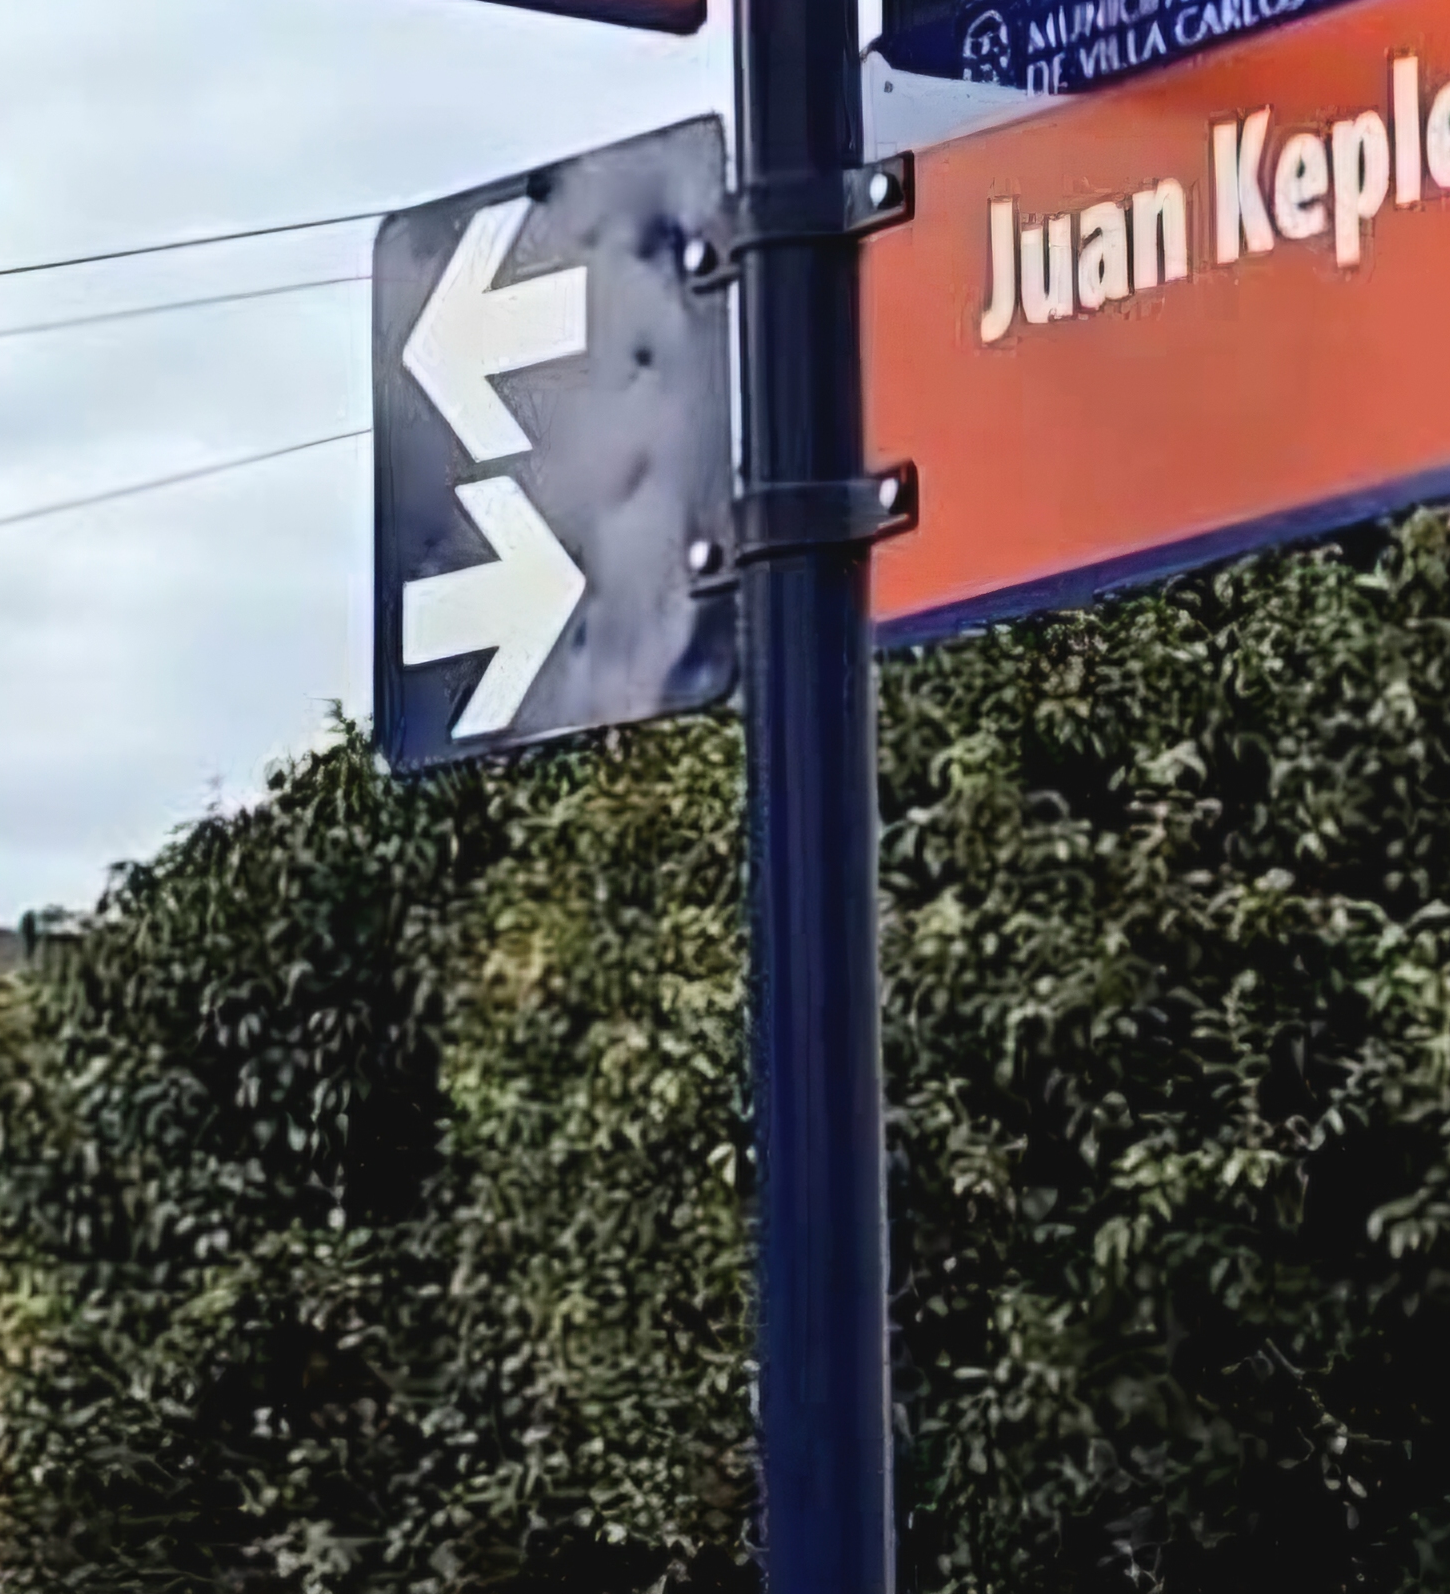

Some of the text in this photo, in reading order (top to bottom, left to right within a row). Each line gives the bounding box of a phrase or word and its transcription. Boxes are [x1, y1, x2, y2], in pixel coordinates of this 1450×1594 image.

[1026, 55, 1069, 99] DE
[1079, 18, 1166, 80] VILLA
[980, 177, 1188, 344] Juan
